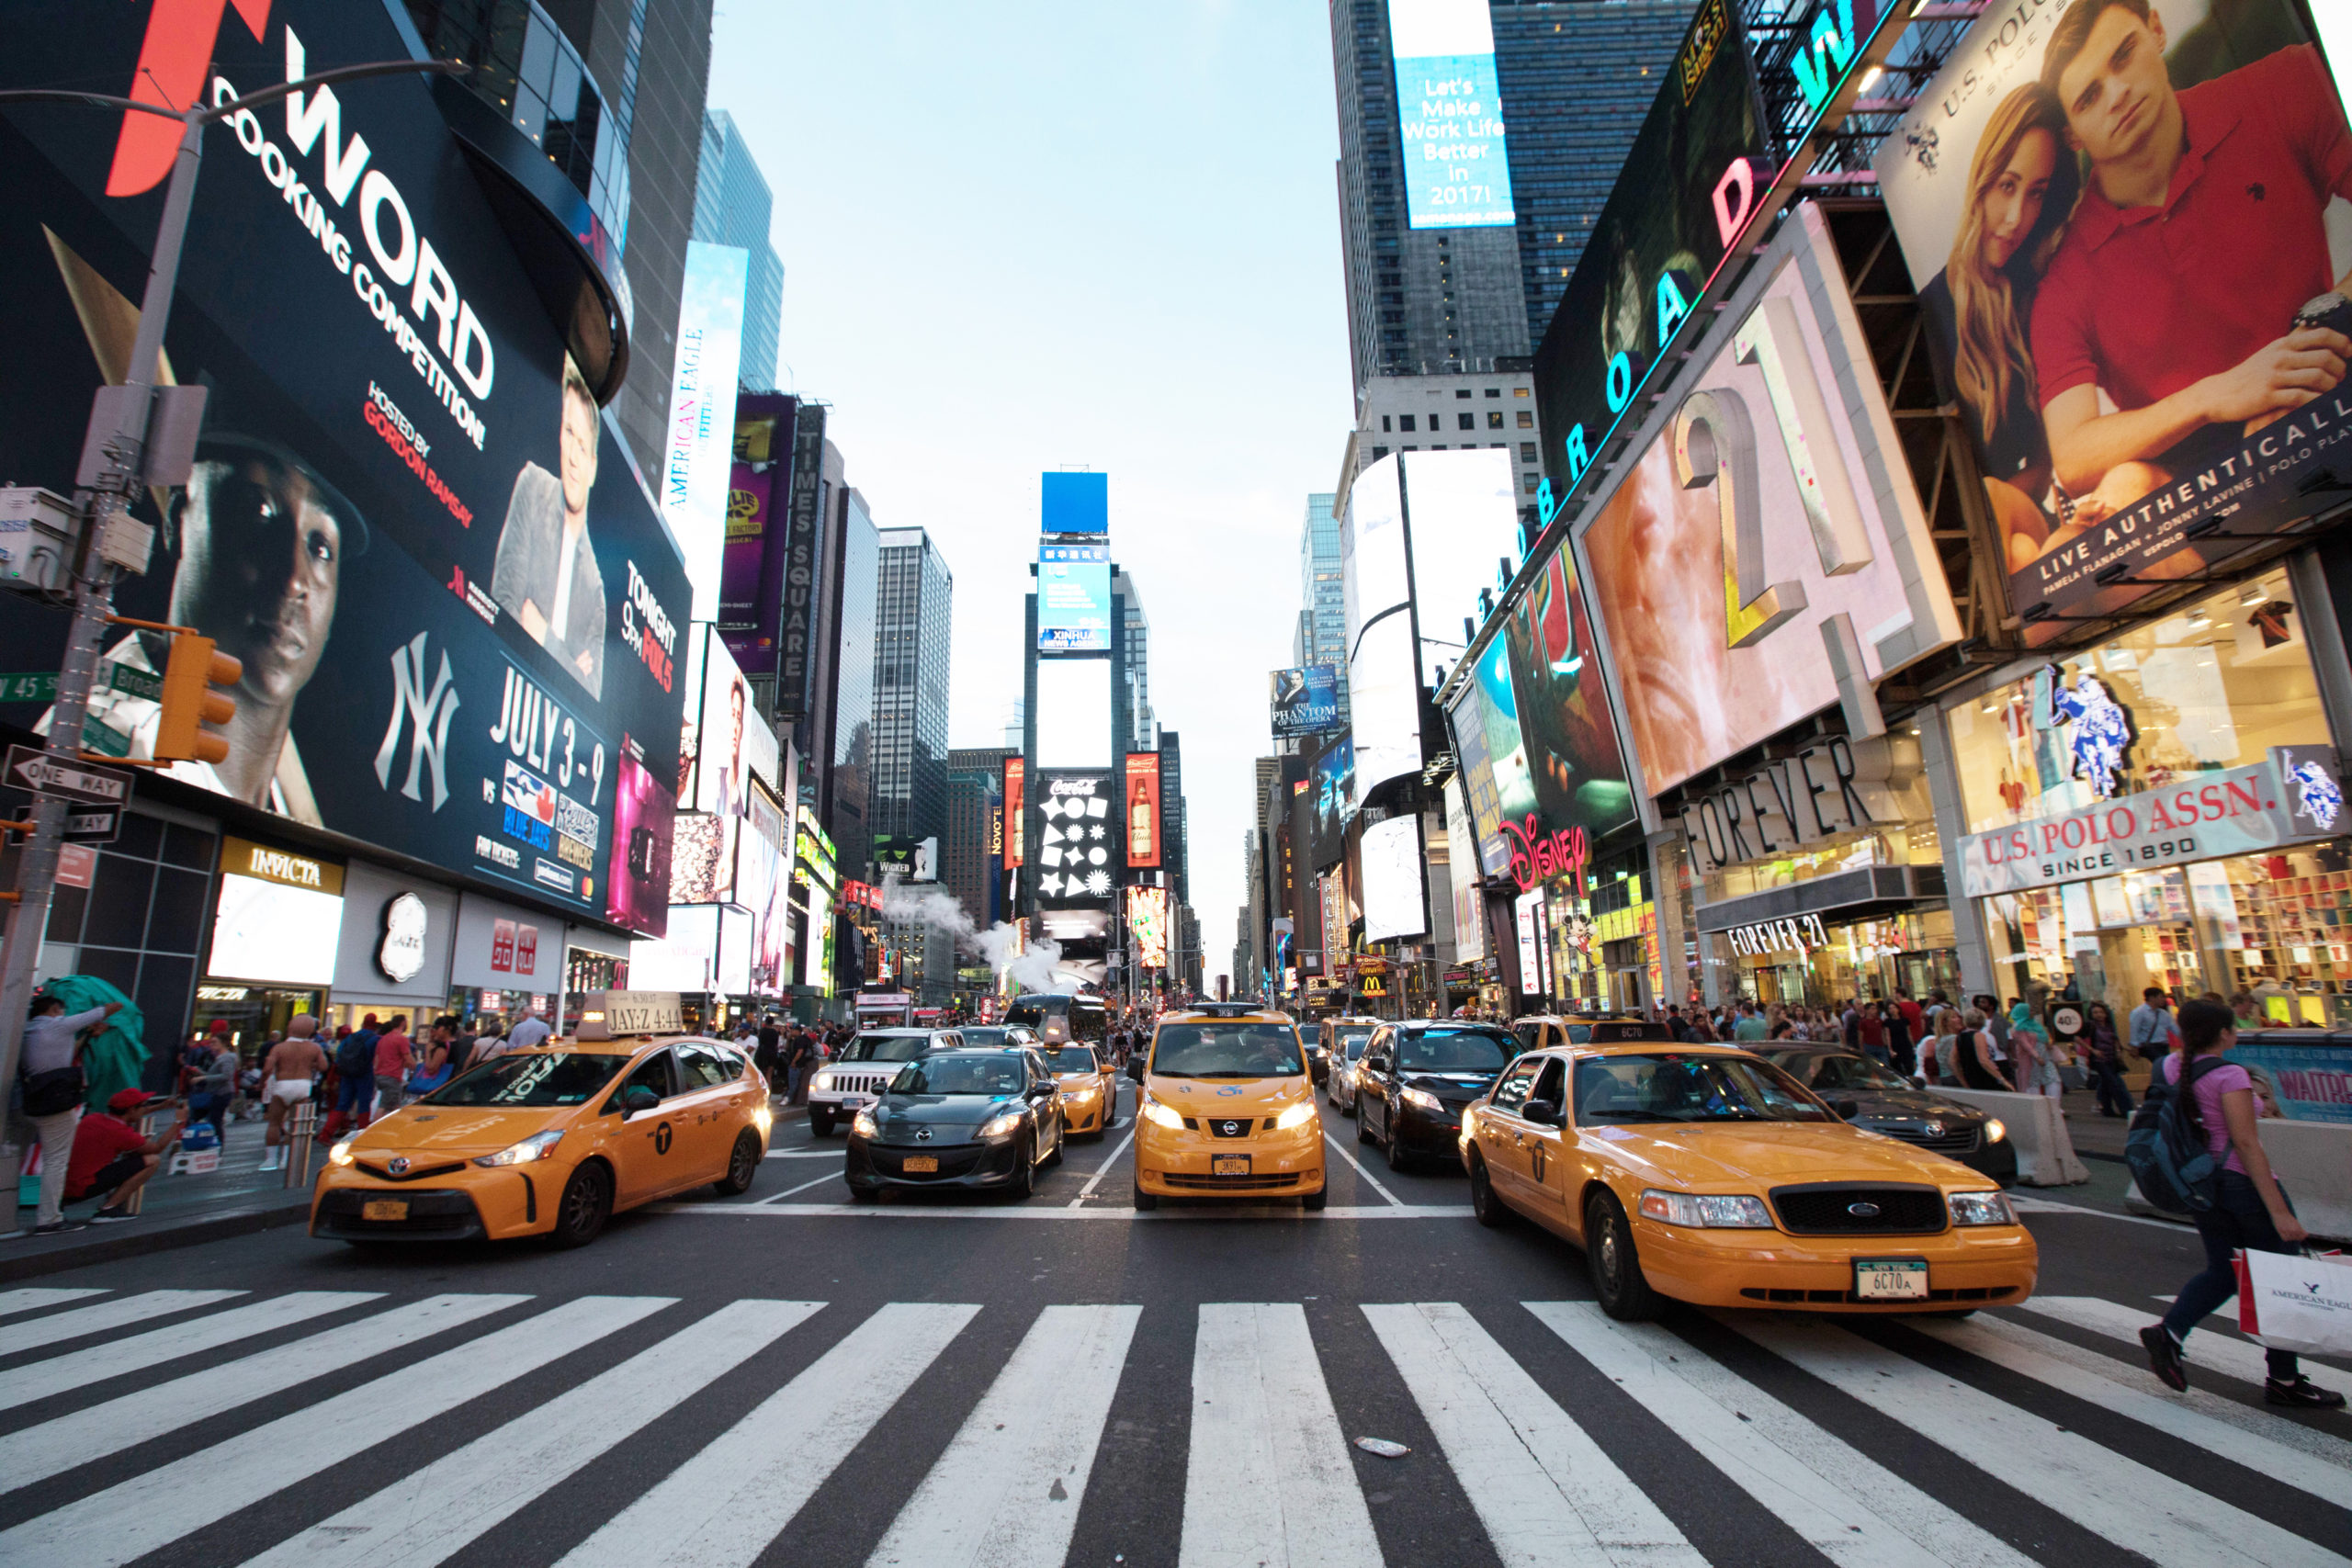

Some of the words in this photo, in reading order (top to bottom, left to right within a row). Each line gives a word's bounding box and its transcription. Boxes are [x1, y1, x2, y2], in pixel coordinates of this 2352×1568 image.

[1425, 77, 1474, 96] Let's
[1422, 98, 1481, 118] Make
[1467, 118, 1505, 137] Life
[1424, 142, 1489, 161] Better
[1448, 164, 1468, 182] in
[285, 23, 495, 401] WORD
[1430, 185, 1490, 205] 2017!
[212, 75, 353, 274] COOKING
[353, 264, 487, 451] COMPETITION!
[680, 328, 704, 392] EAGLE
[368, 380, 415, 441] HOSTED
[414, 433, 431, 458] BY
[364, 400, 426, 480] GORDON
[425, 468, 473, 528] RAMSAY
[670, 398, 695, 512] AMERICAN
[795, 432, 819, 533] TIMES
[2043, 571, 2082, 596] PAMELA
[2082, 536, 2143, 575] FLANAGAN
[2156, 505, 2199, 536] JONNY
[2203, 477, 2255, 510] LAVINE
[2268, 447, 2312, 476] POLO
[2040, 542, 2090, 581] LIVE
[628, 559, 676, 656] TONIGHT
[785, 545, 812, 678] SQUARE
[1053, 630, 1095, 640] XINHUA
[641, 626, 663, 685] FOX
[662, 659, 673, 694] 5
[14, 677, 38, 698] 45
[490, 666, 560, 774] JULY
[1272, 705, 1336, 721] PHANTOM
[1291, 716, 1305, 725] THE
[1306, 716, 1331, 724] OPERA
[28, 761, 64, 784] ONE
[80, 773, 119, 796] WAY
[482, 777, 496, 805] VS
[1467, 756, 1493, 794] COME
[72, 814, 107, 829] WAY
[1679, 735, 1872, 875] FOREVER
[1982, 832, 2036, 867] U.S.
[2041, 807, 2136, 856] POLO
[2149, 775, 2277, 834] ASSN.
[475, 835, 492, 858] FOR
[503, 805, 528, 842] BLUE
[527, 818, 550, 852] JAYS
[992, 805, 1001, 855] NOVOTEL
[251, 848, 321, 886] INVICTA
[558, 834, 594, 872] BREWERS
[2042, 852, 2114, 878] SINCE
[2125, 837, 2198, 863] 1890
[1325, 884, 1335, 956] PALACE
[1727, 917, 1806, 957] FOREVER
[1803, 913, 1828, 947] 21
[518, 952, 534, 972] QLO
[609, 1009, 650, 1031] JAY:Z
[654, 1008, 681, 1030] 4:44
[1622, 1027, 1643, 1037] 6C70
[2272, 1289, 2325, 1305] AMERICAN
